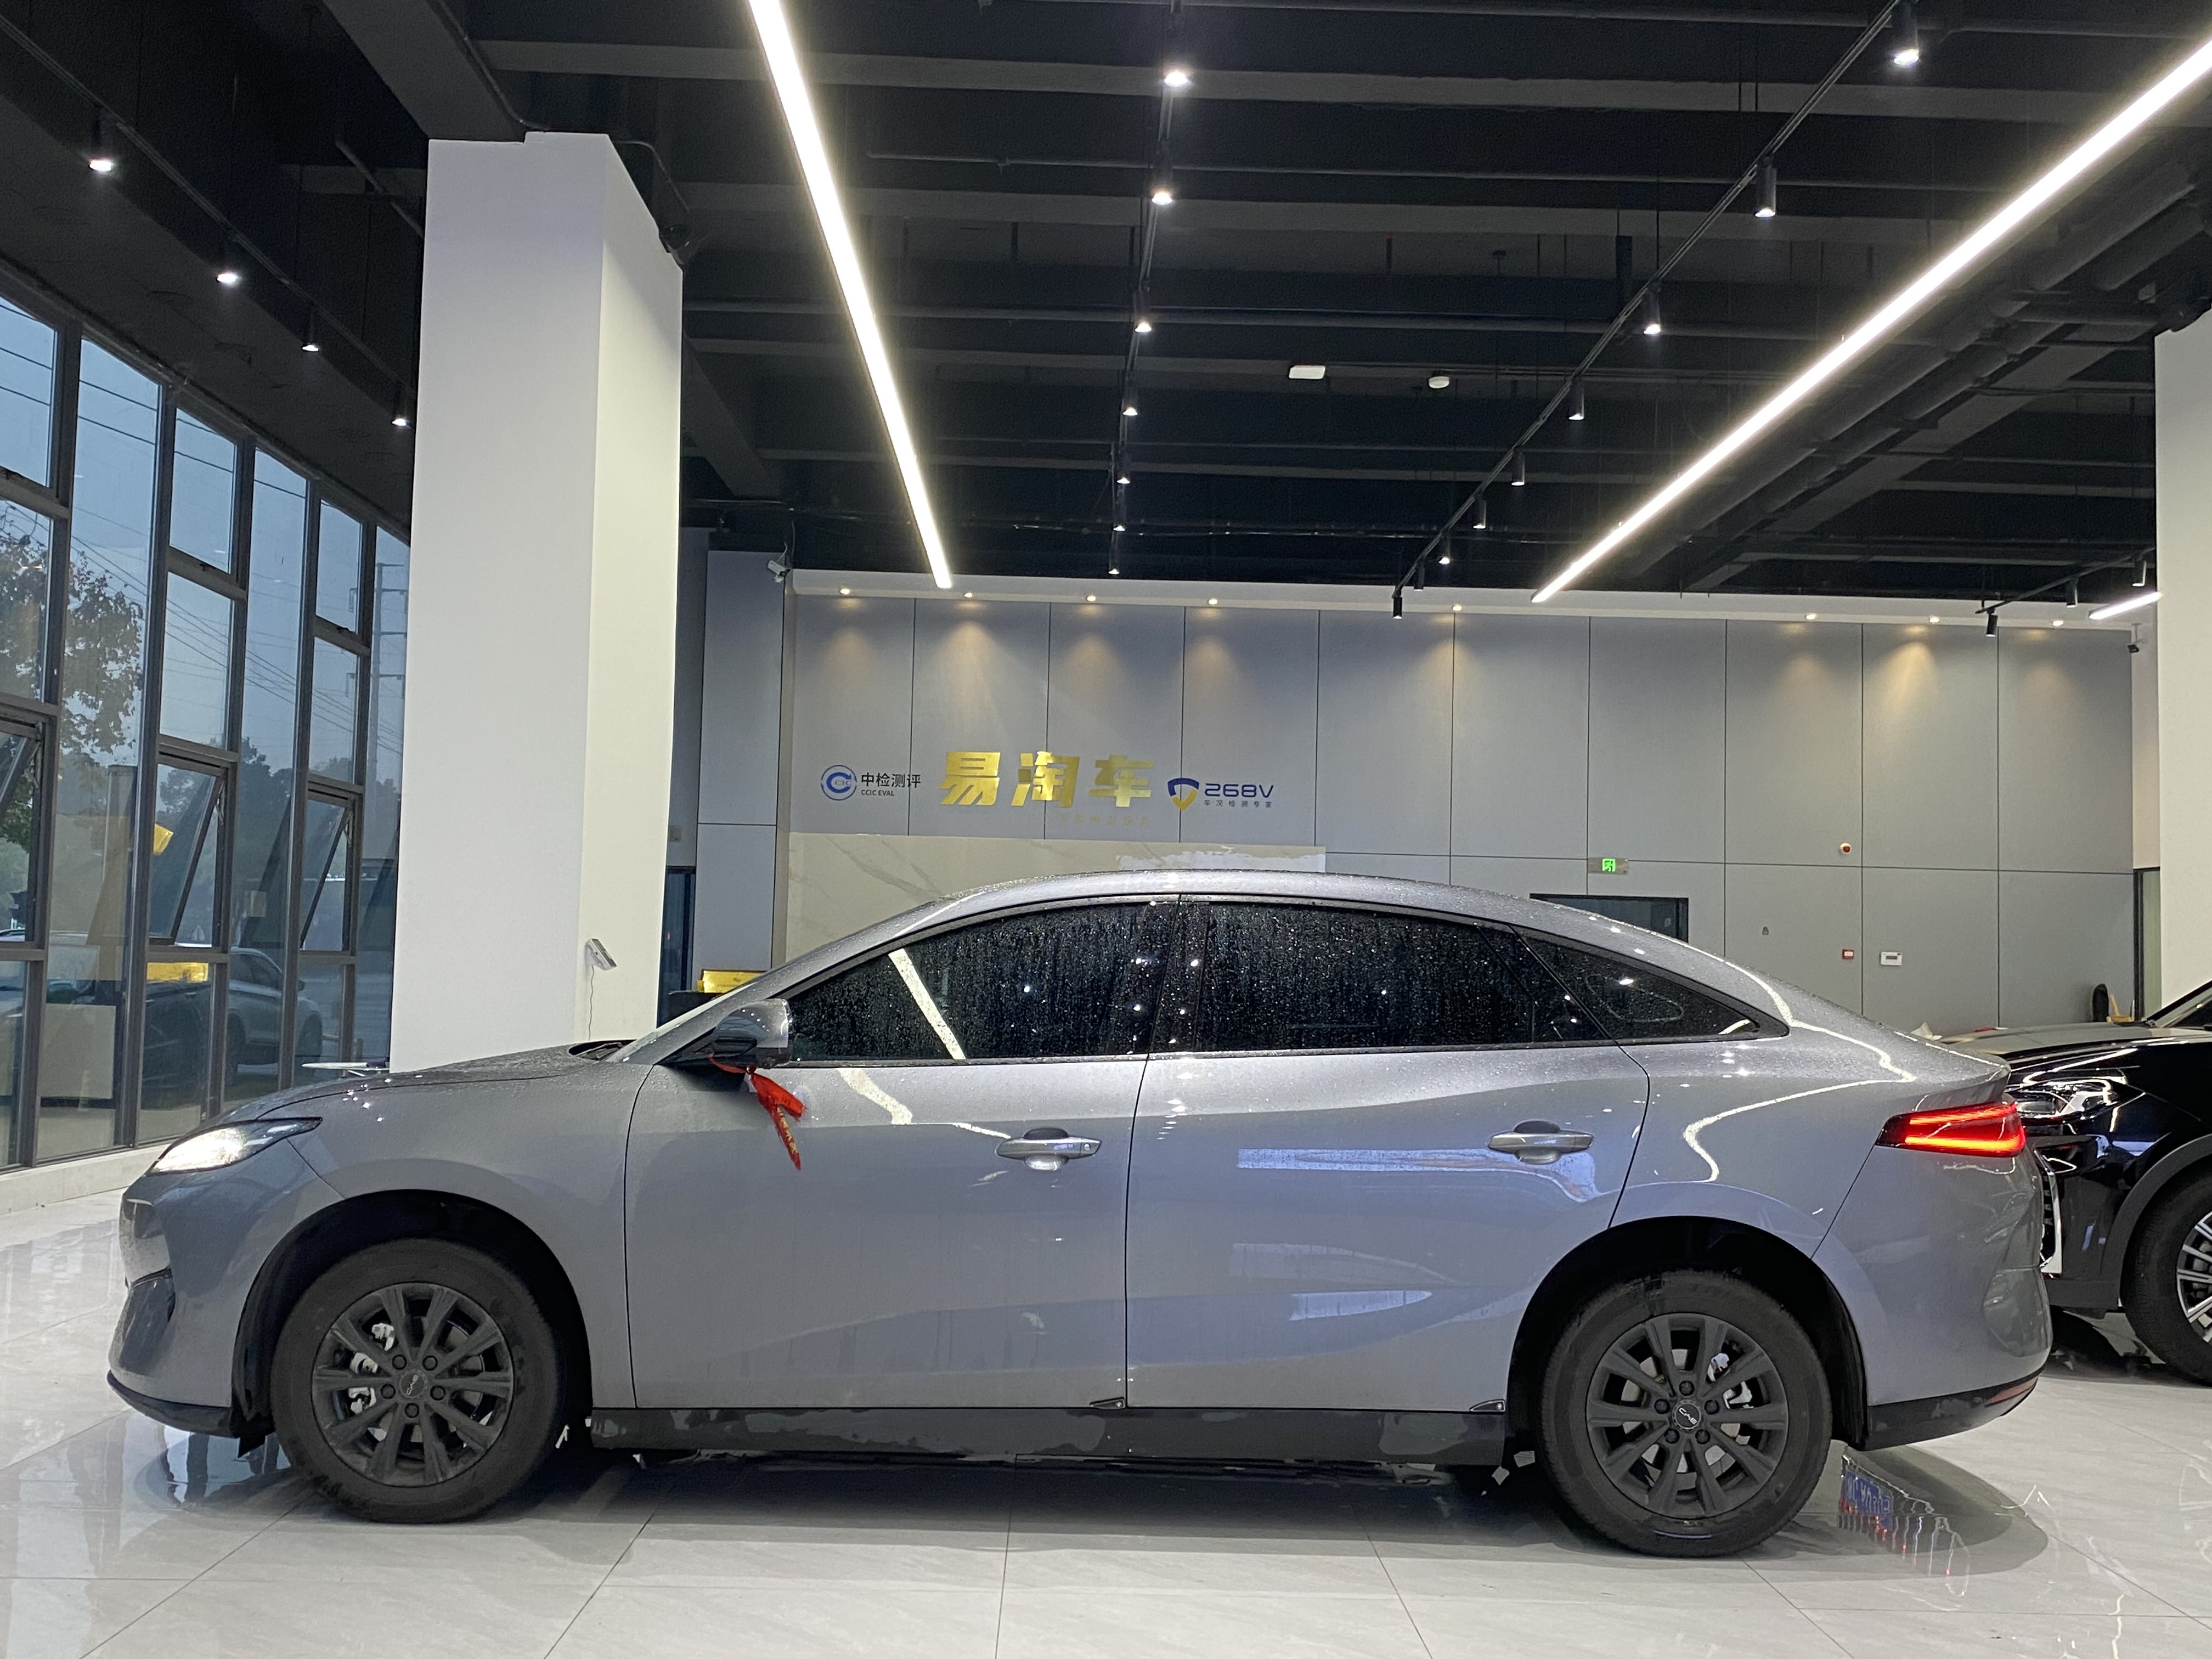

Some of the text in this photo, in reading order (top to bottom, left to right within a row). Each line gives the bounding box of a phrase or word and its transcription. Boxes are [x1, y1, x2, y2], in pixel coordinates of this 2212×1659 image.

[861, 772, 921, 788] 中检测评
[940, 751, 1153, 808] 易淘车
[1205, 783, 1274, 798] 268V
